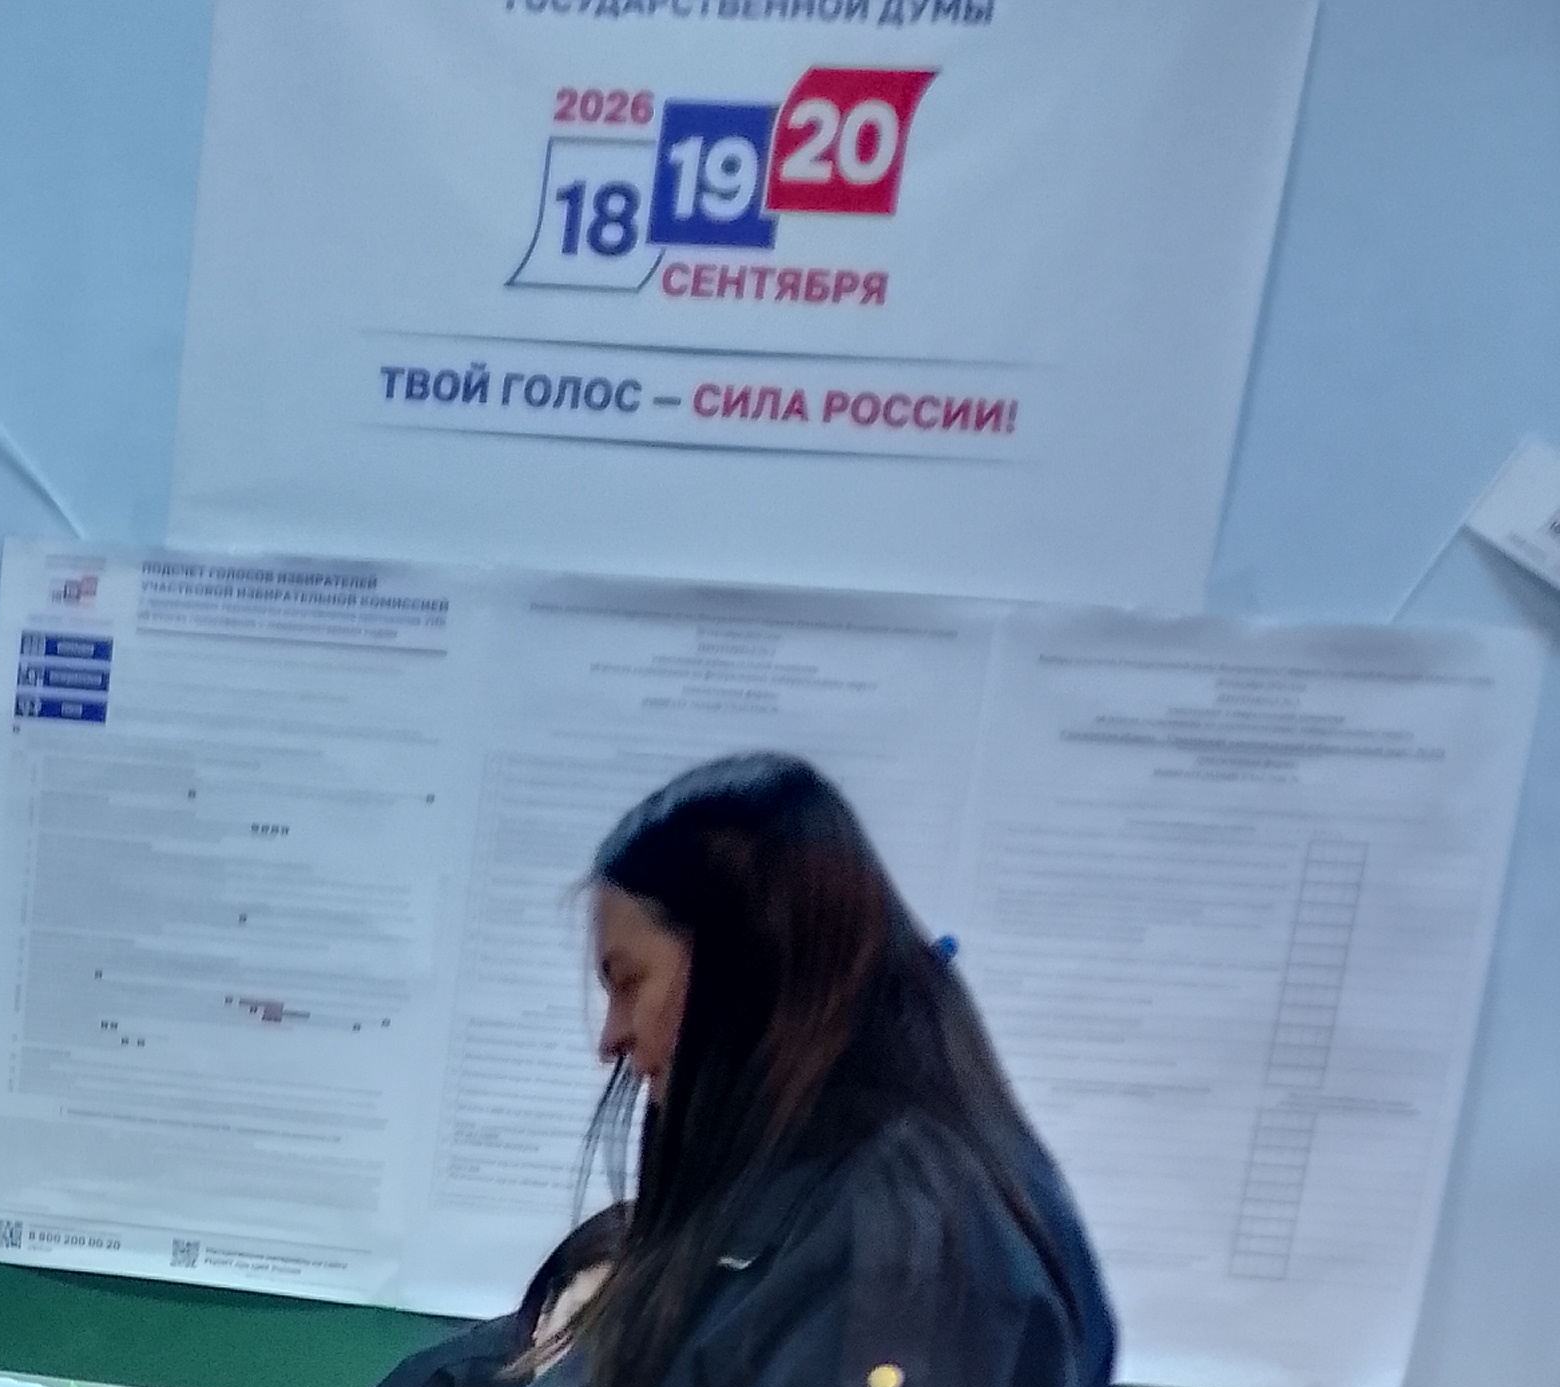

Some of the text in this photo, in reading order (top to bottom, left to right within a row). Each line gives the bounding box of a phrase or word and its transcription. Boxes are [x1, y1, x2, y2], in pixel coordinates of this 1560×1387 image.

[876, 0, 993, 28] ДУМЫ
[553, 86, 655, 126] 2026
[554, 98, 900, 259] 18 19 20
[661, 261, 890, 307] СЕНТЯБРЯ
[380, 362, 490, 405] ТВОЙ
[501, 372, 642, 413] ГОЛОС
[693, 382, 809, 424] СИЛА
[823, 388, 1019, 435] РОССИИ!
[276, 568, 378, 590] ИЗБИРАТЕЛЕЙ
[63, 1234, 86, 1247] 200
[106, 1239, 122, 1251] 20
